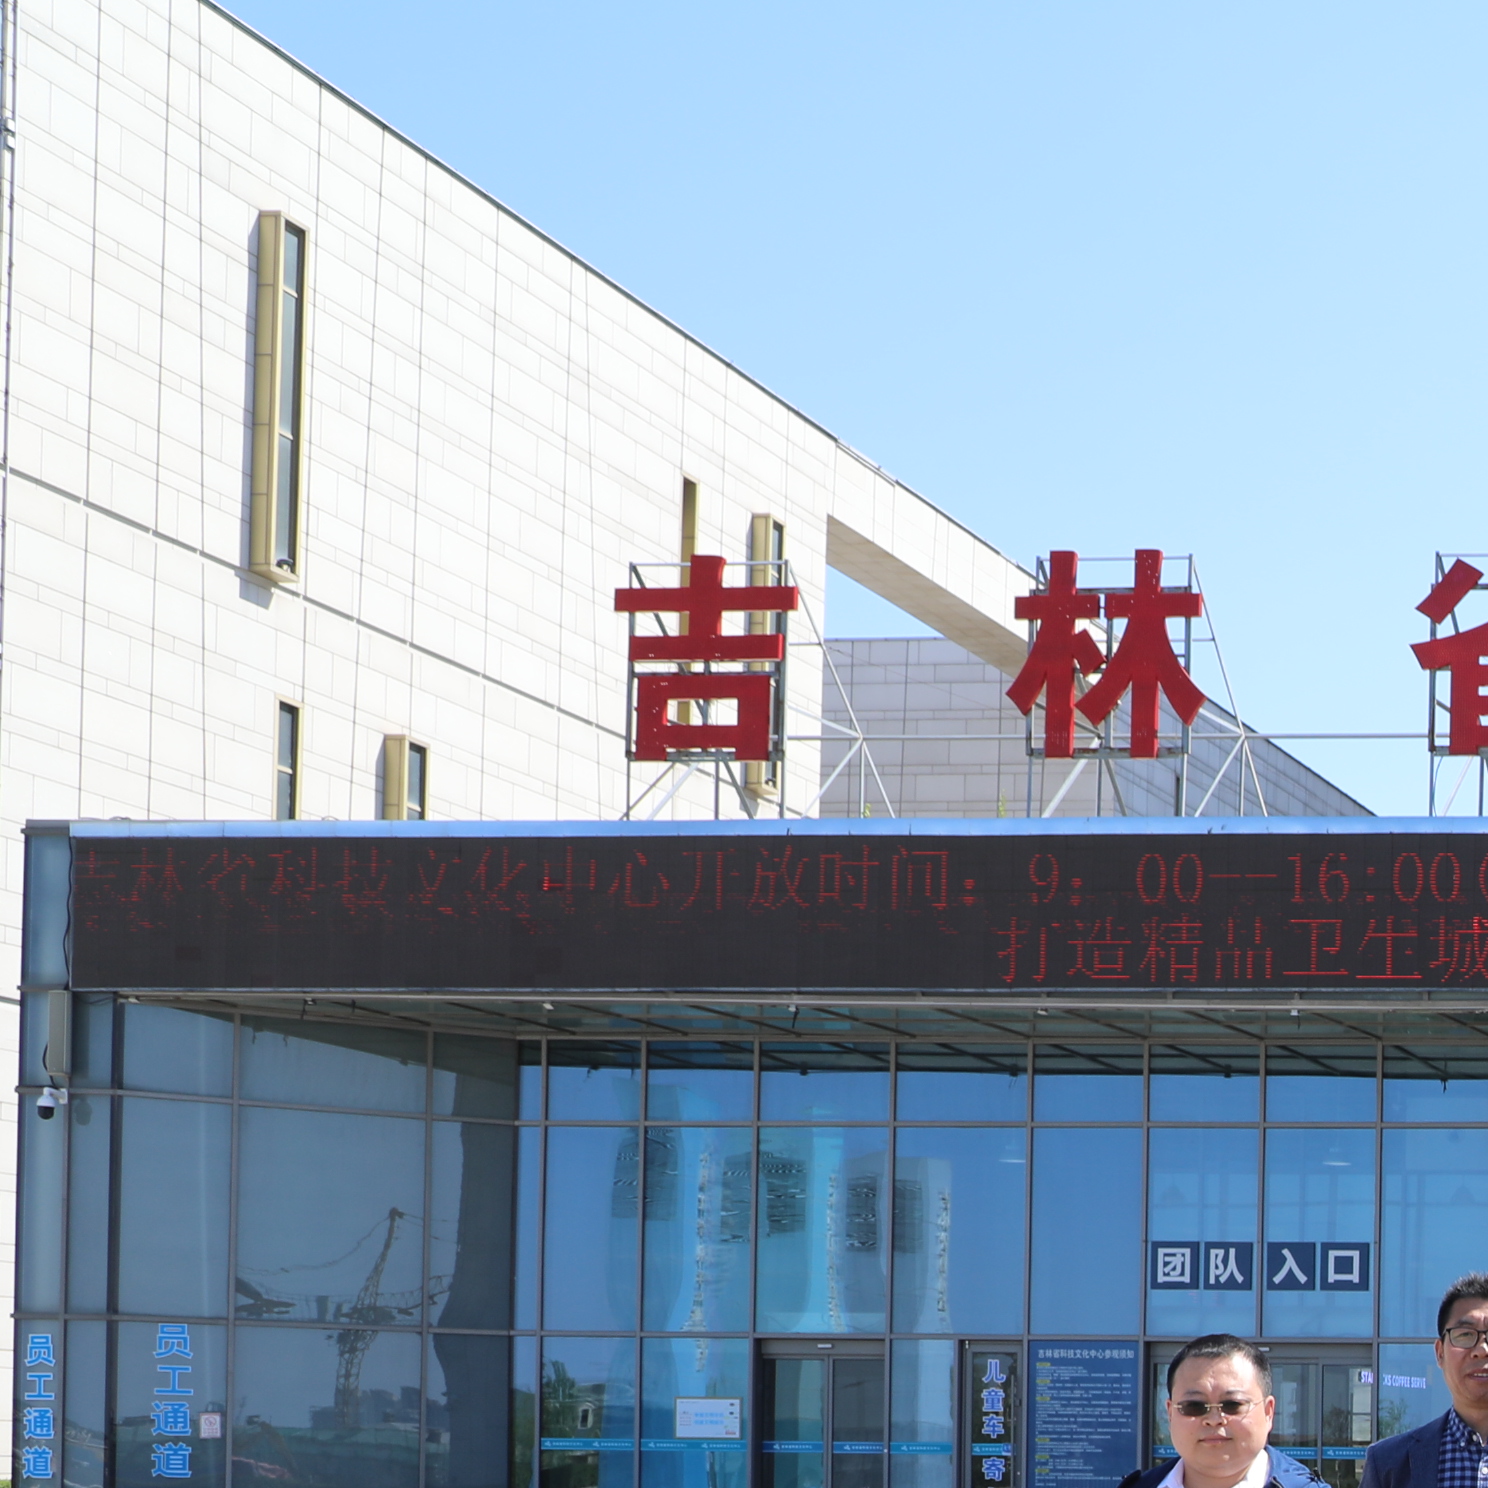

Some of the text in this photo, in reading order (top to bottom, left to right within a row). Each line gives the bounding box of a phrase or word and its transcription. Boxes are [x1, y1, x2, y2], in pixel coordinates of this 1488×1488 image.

[1156, 1247, 1361, 1285] 团队入口
[22, 1333, 56, 1480] 员工通道
[151, 1323, 194, 1479] 员工通道
